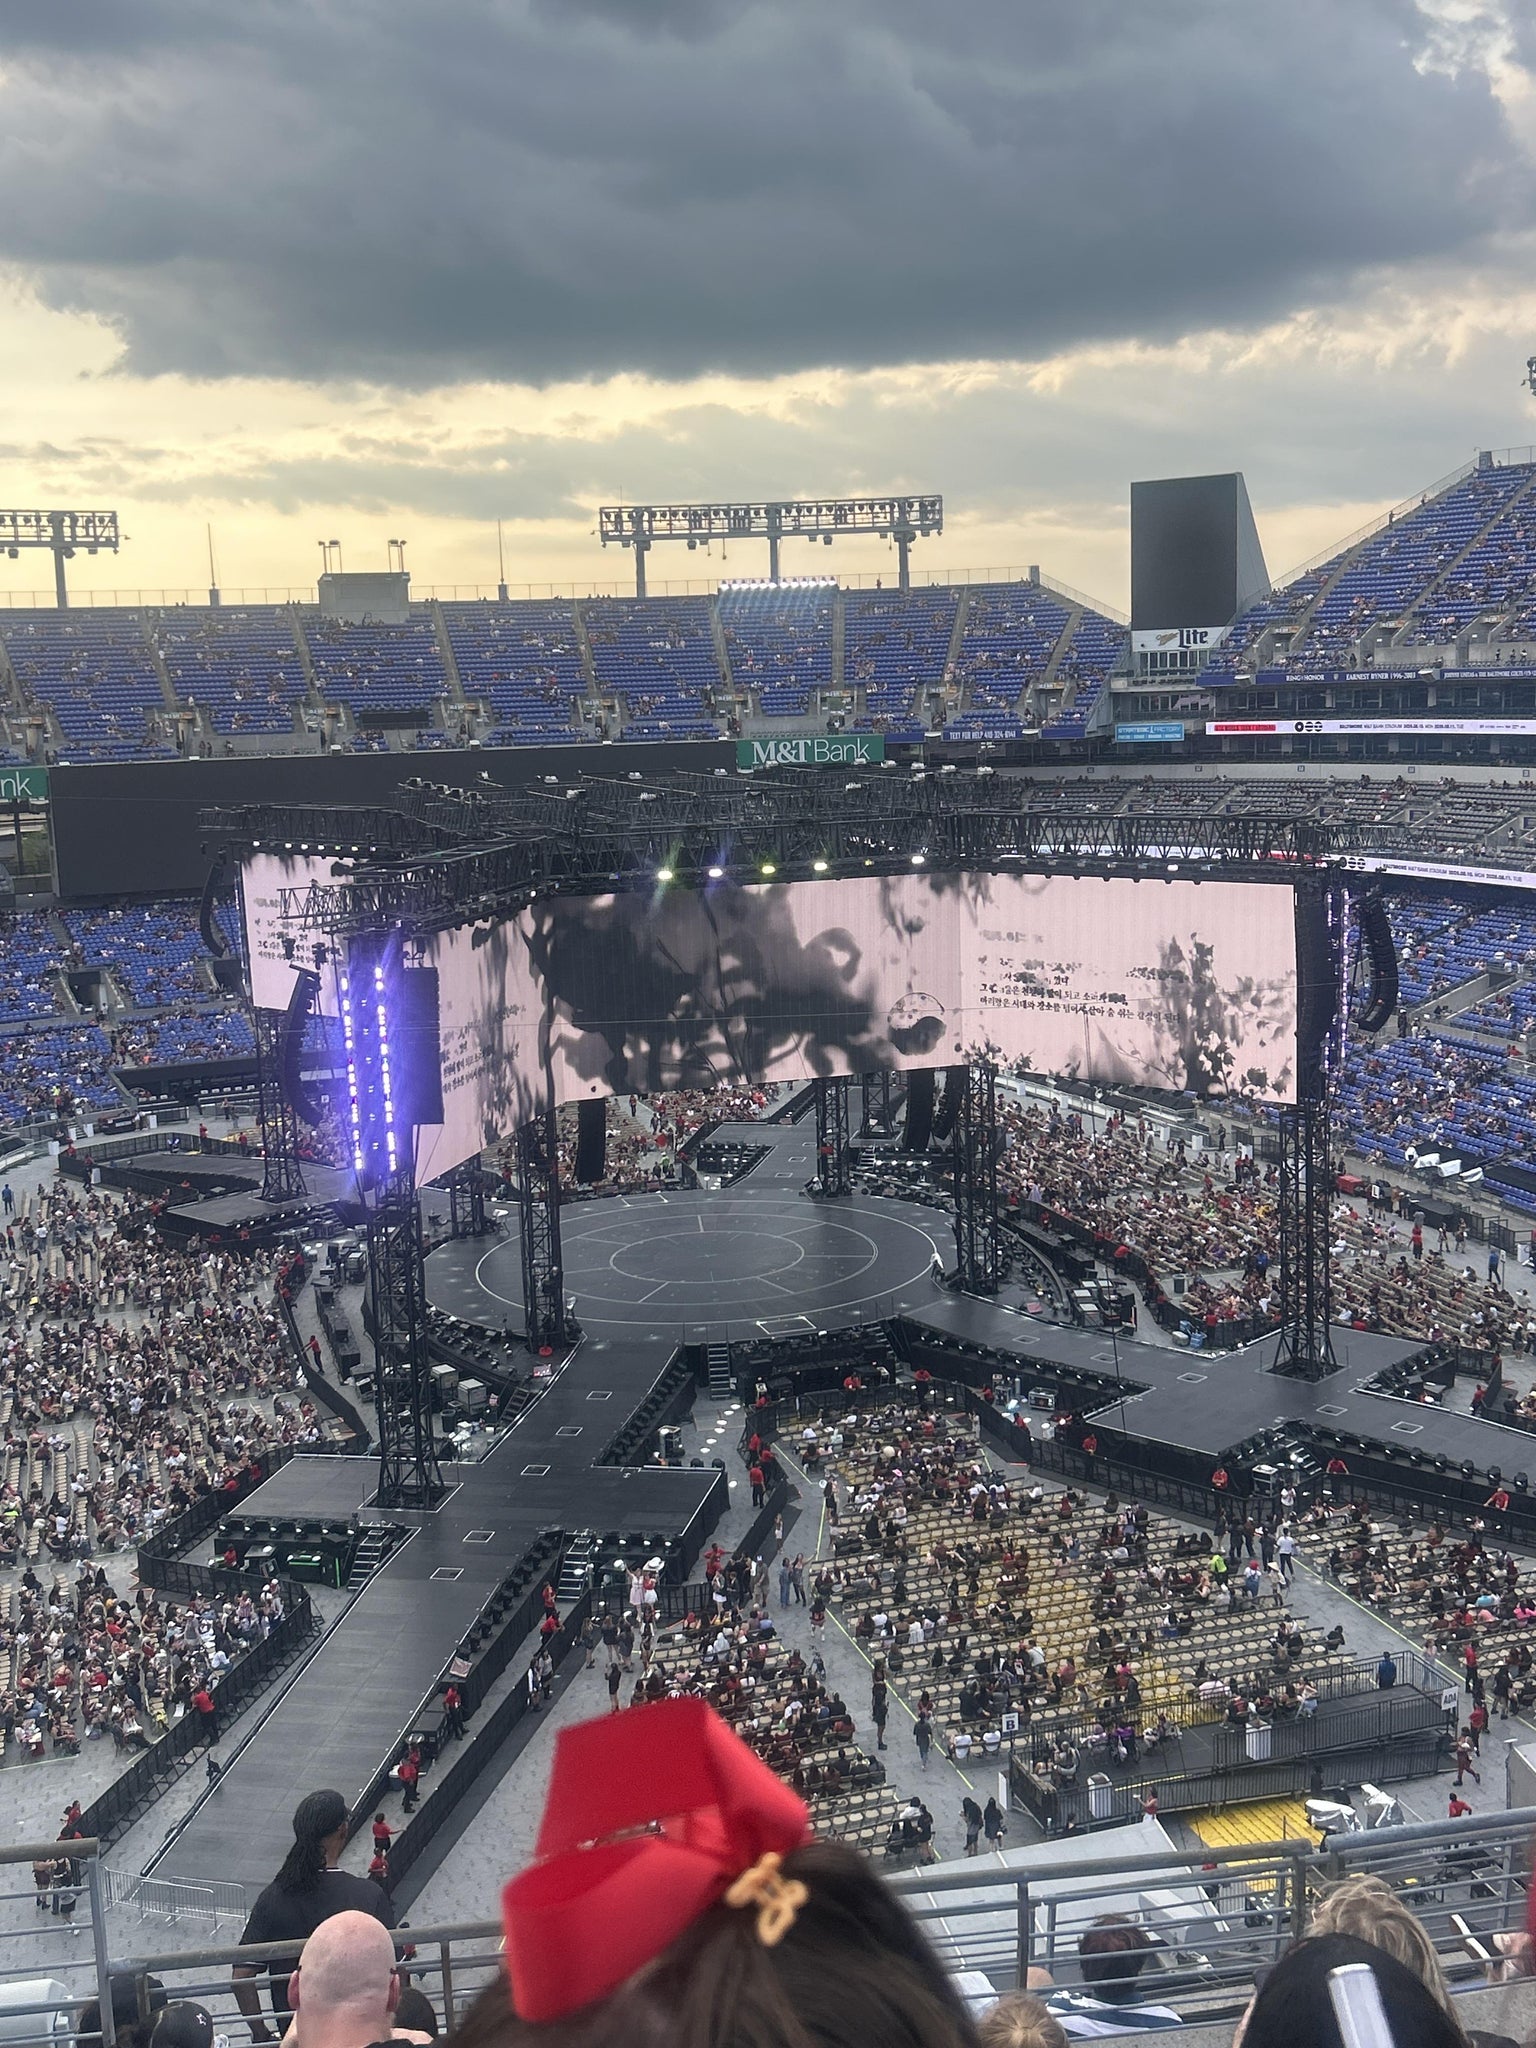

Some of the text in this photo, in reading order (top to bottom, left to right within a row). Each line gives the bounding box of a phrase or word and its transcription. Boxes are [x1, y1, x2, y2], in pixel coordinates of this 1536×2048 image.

[1178, 629, 1209, 649] Lite
[751, 737, 871, 765] M&T Bank
[0, 771, 33, 797] nk
[1006, 1720, 1015, 1730] B
